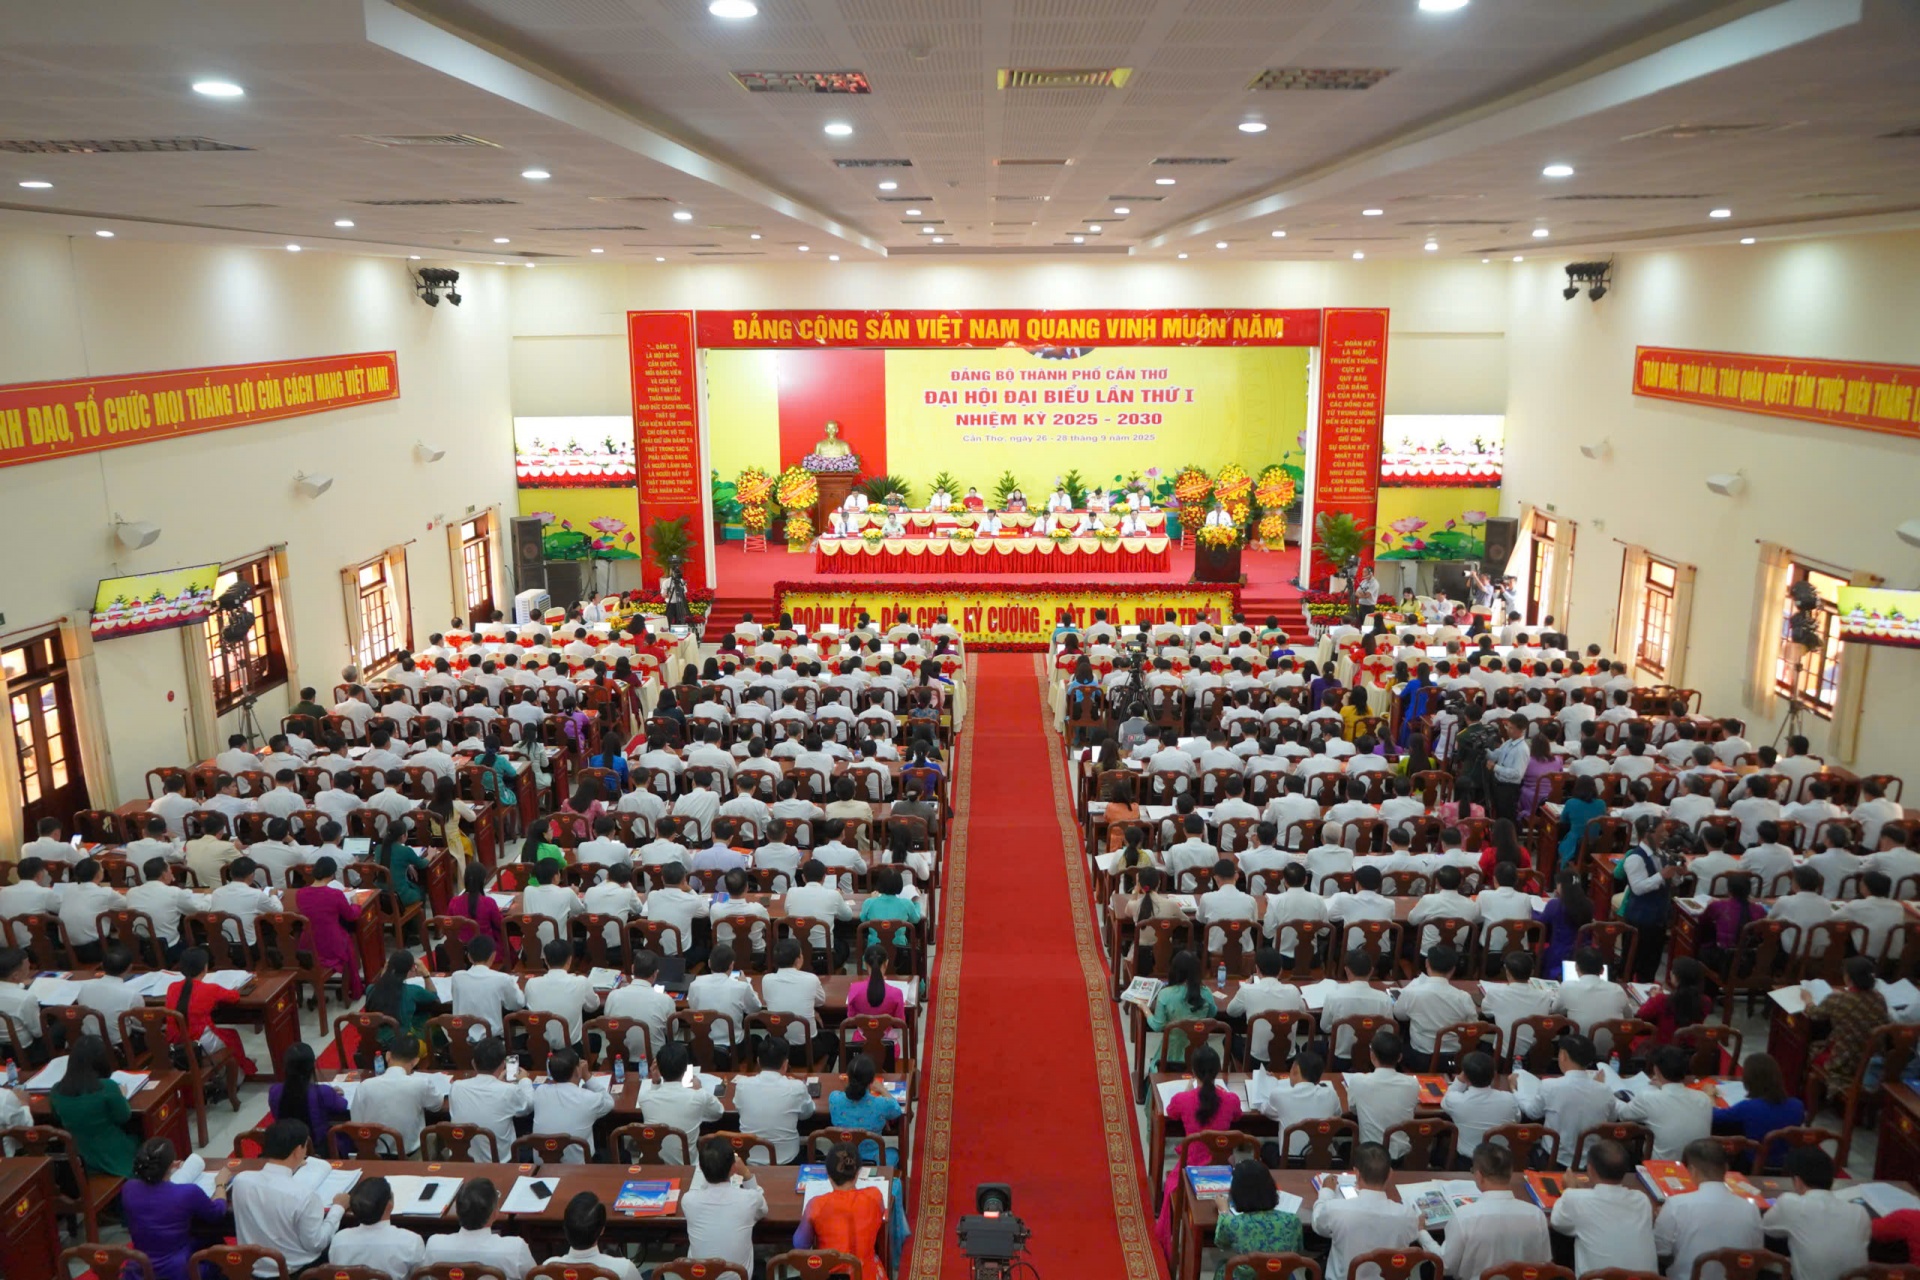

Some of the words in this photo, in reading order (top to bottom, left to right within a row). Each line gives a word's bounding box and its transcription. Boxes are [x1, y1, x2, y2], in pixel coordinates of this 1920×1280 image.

[733, 312, 792, 339] ĐẢNG
[866, 312, 910, 339] SẢN
[916, 315, 963, 343] VIỆT
[970, 319, 1019, 339] NAM
[1026, 319, 1100, 341] QUANG
[1106, 318, 1156, 339] VINH
[1162, 314, 1226, 339] MUÔN
[1233, 314, 1284, 339] NĂM
[951, 367, 991, 381] ĐẢNG
[996, 368, 1015, 383] BỘ
[1019, 367, 1067, 381] THÀNH
[1072, 365, 1101, 380] PHỐ
[1106, 366, 1135, 380] CẦN
[1140, 368, 1168, 380] THƠ
[27, 403, 74, 450] ĐẠO,
[74, 387, 101, 438] TỔ
[104, 390, 152, 434] CHỨC
[154, 390, 184, 430] MỌI
[187, 377, 233, 420] THẮNG
[236, 378, 256, 418] LỢI
[257, 372, 283, 409] CỦA
[283, 371, 315, 405] CÁCH
[316, 370, 344, 405] MẠNG
[345, 364, 365, 399] VIỆT
[367, 365, 390, 392] NAM!
[924, 390, 957, 407] ĐẠI
[965, 387, 997, 407] HỘI
[1004, 390, 1037, 407] ĐẠI
[1044, 384, 1089, 404] BIỂU
[1096, 384, 1134, 403] LẦN
[1141, 385, 1180, 403] THỨ
[1184, 389, 1194, 402] I
[956, 411, 1017, 428] NHIỆM
[1023, 411, 1047, 426] KỲ
[1053, 413, 1098, 425] 2025
[1117, 413, 1162, 425] 2030
[1010, 434, 1032, 443] ngày
[1056, 434, 1068, 442] 28
[1070, 434, 1098, 443] tháng
[1100, 434, 1106, 442] 9
[1109, 434, 1130, 442] năm
[1133, 434, 1156, 442] 2025
[963, 600, 983, 633] KỶ
[988, 602, 1040, 633] CƯƠNG
[1135, 603, 1174, 625] PHÁ
[1178, 598, 1221, 625] TRỂN
